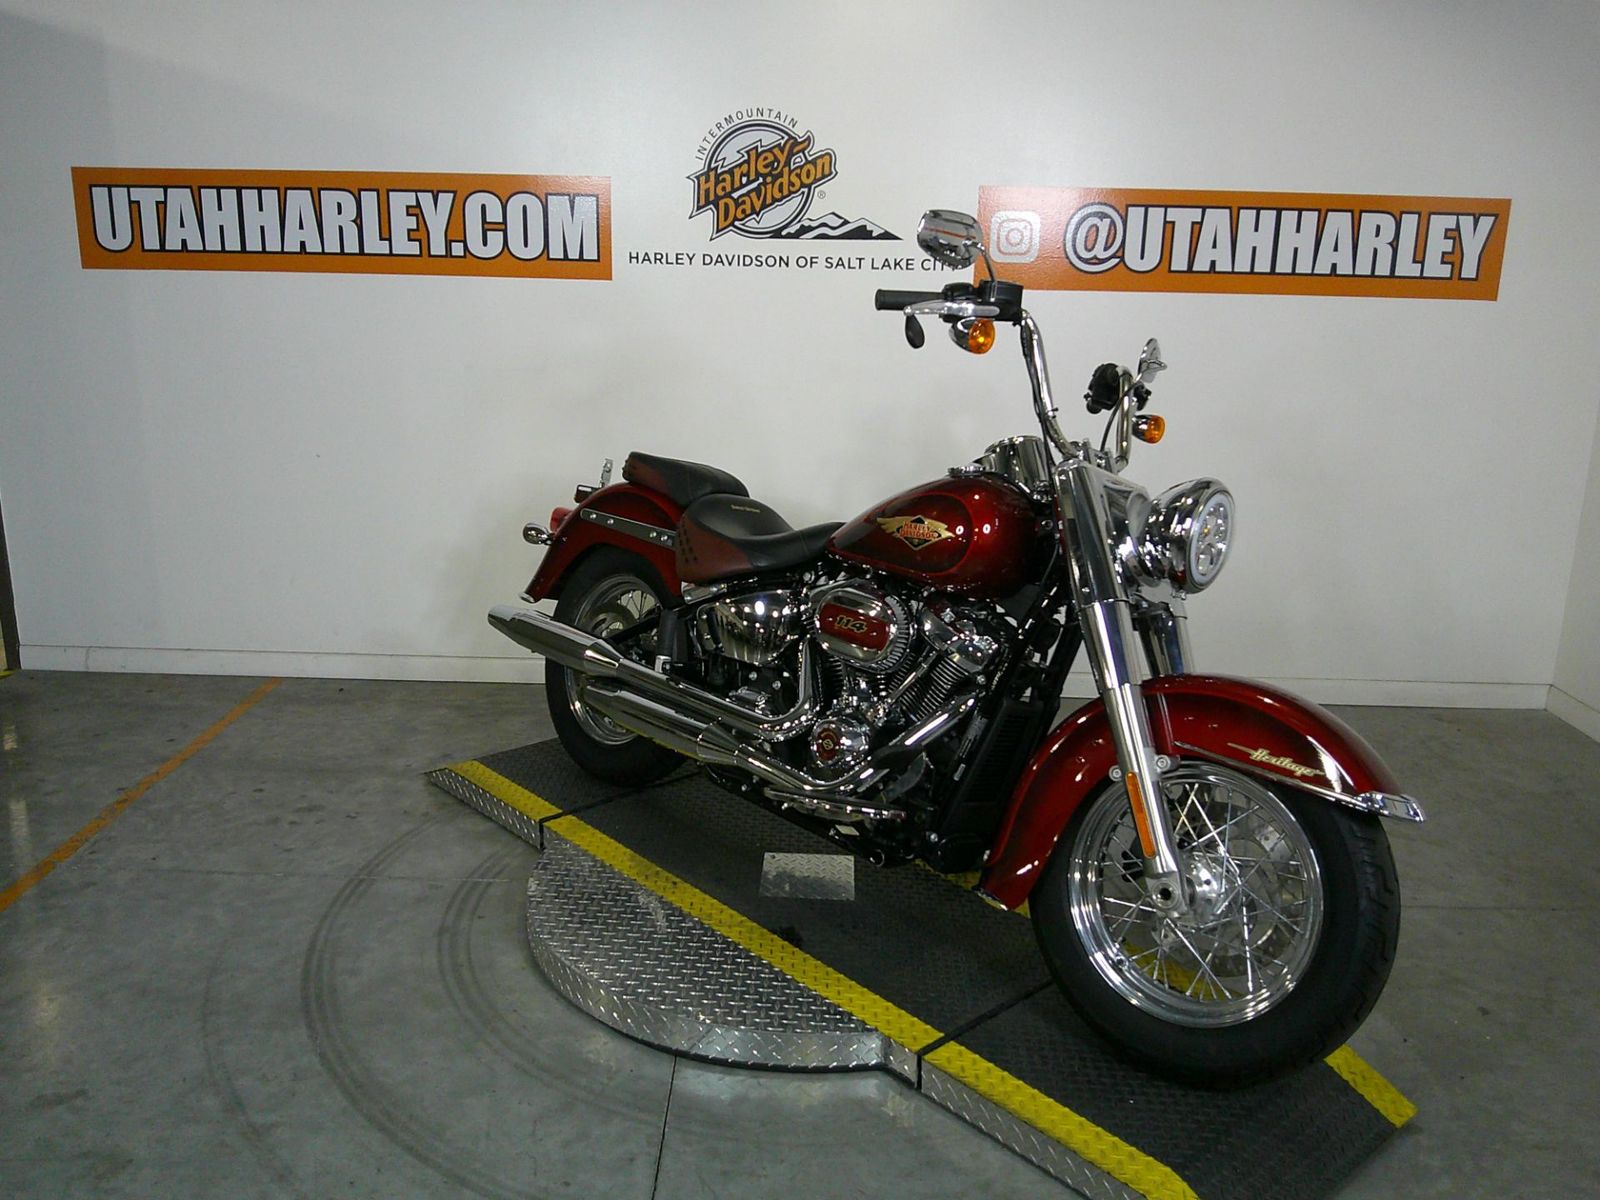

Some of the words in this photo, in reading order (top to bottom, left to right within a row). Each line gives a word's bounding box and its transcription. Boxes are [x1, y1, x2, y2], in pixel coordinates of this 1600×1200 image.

[695, 107, 798, 160] INTERMOUNTAIN
[697, 134, 813, 208] Harley
[717, 153, 832, 231] Davidson
[89, 184, 600, 262] UTAHHARLEY.COM
[1064, 202, 1499, 281] @UTAHHARLEY
[628, 251, 696, 267] HARLEY
[702, 253, 790, 269] DAVIDSON
[796, 255, 820, 269] OF
[825, 257, 865, 270] SALT
[871, 258, 915, 271] LAKE
[920, 258, 956, 272] CI
[835, 614, 868, 633] 114
